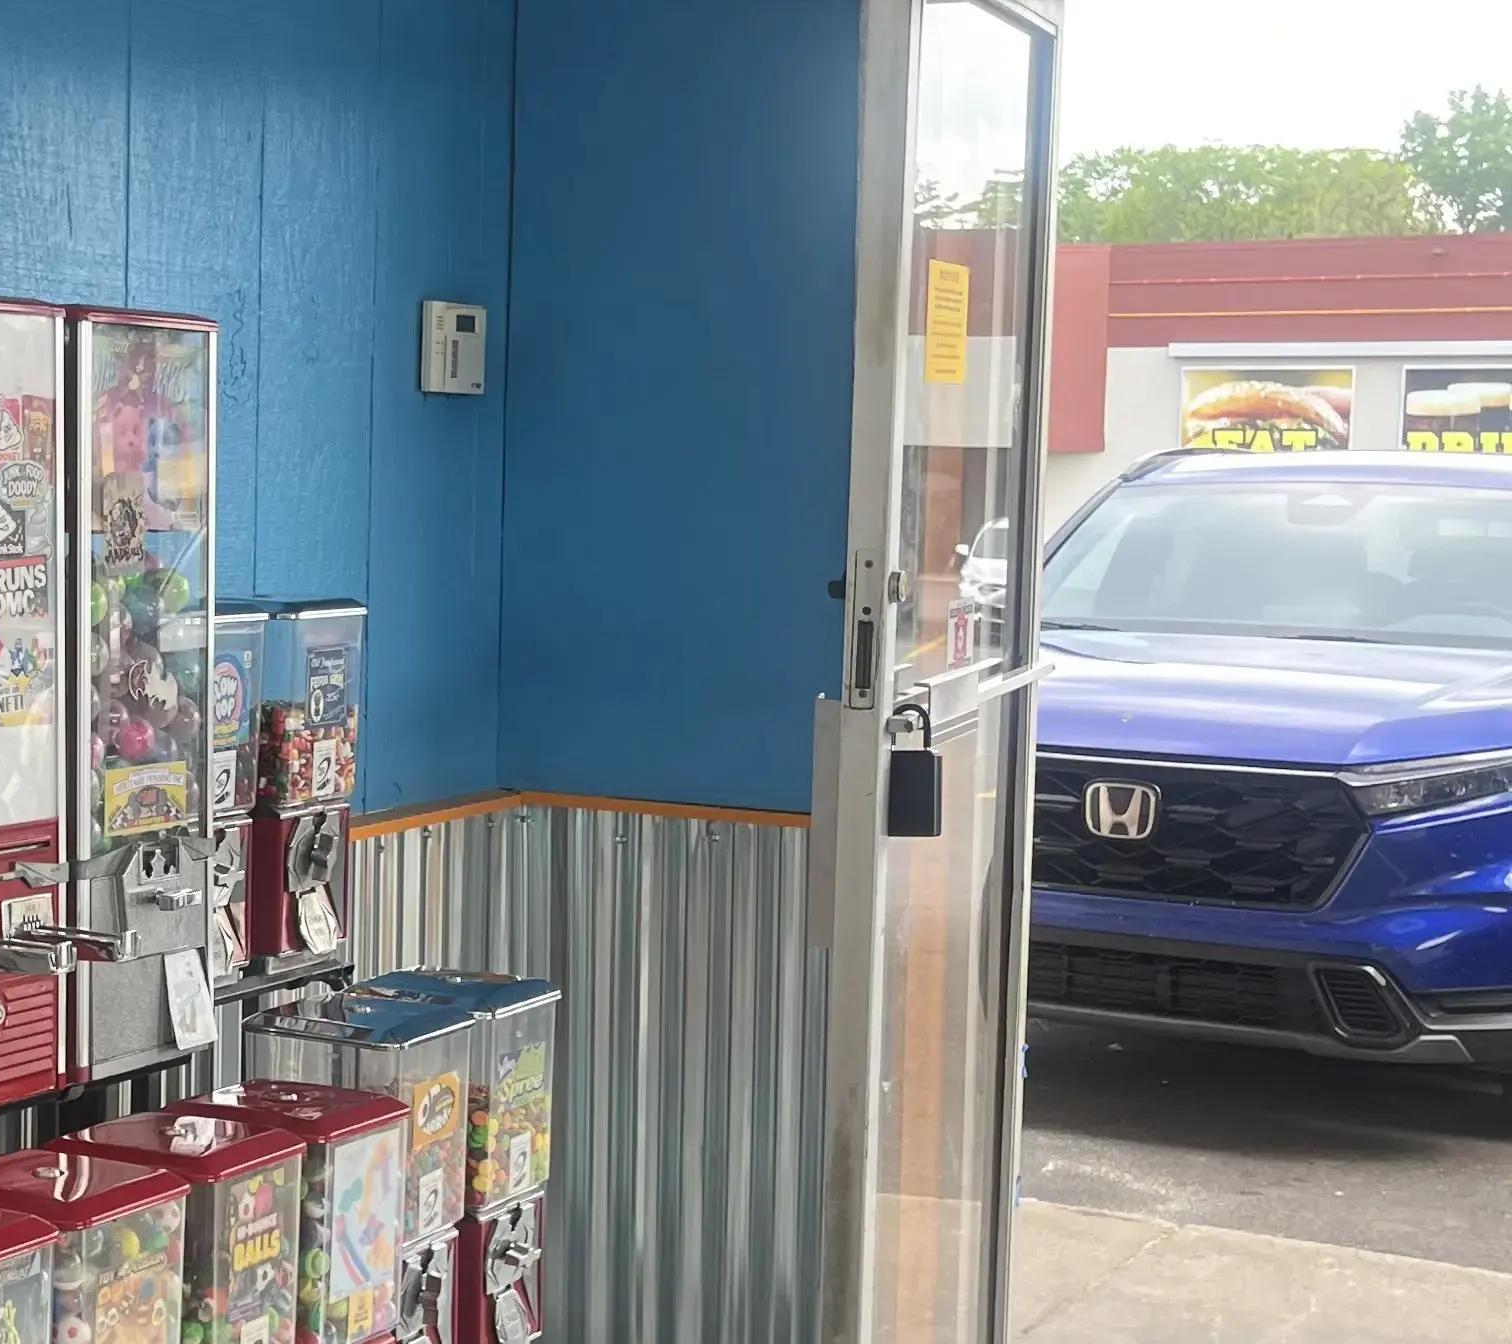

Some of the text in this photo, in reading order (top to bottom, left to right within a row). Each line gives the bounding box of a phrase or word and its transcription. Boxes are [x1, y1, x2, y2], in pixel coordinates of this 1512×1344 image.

[1406, 431, 1512, 453] DRI
[2, 465, 21, 485] JUNK
[25, 463, 44, 482] FOOD
[7, 480, 39, 499] DOODY
[496, 1073, 543, 1108] Spree
[234, 1229, 281, 1272] BALLS
